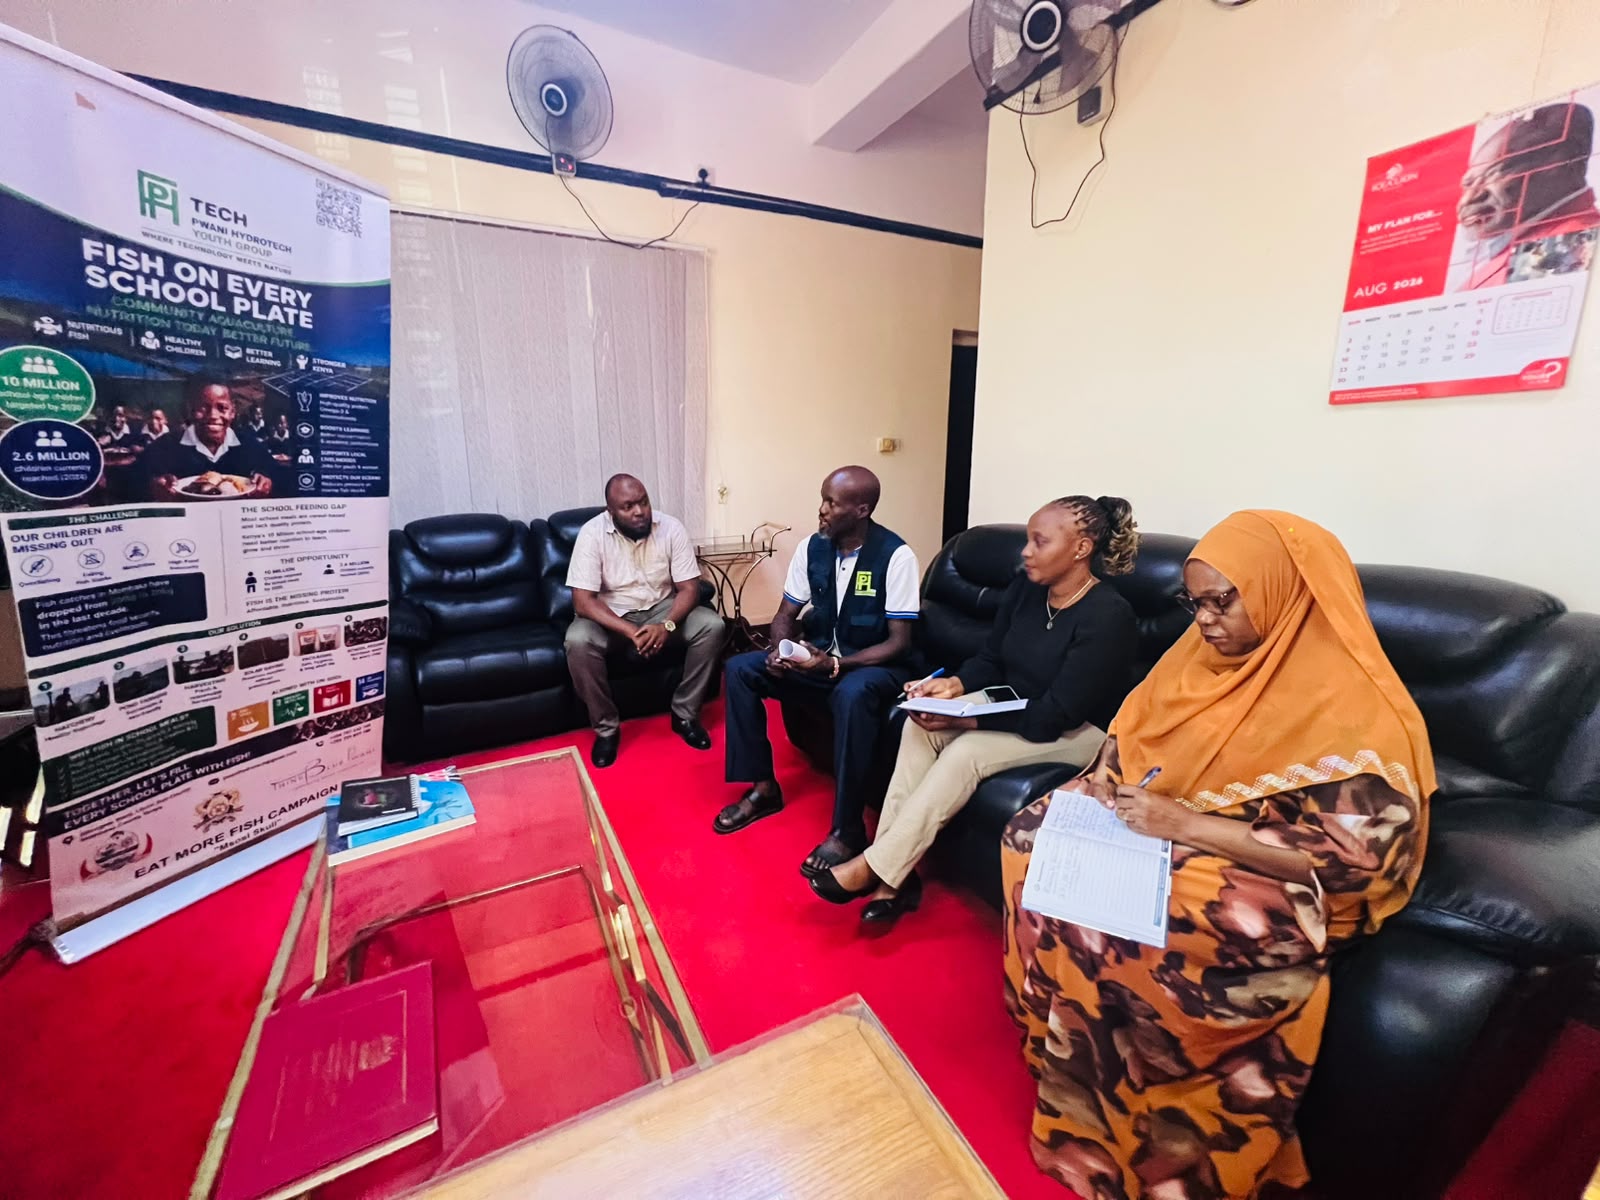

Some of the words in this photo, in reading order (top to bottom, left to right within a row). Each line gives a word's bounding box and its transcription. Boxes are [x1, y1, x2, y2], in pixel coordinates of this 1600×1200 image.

[190, 197, 248, 227] TECH
[1368, 224, 1383, 234] MY
[1384, 216, 1412, 230] PLAN
[192, 218, 228, 235] PWANI
[232, 230, 292, 253] HYDROTECH
[192, 229, 232, 248] YOUTH
[236, 242, 272, 258] GROUP
[142, 231, 174, 246] WHERE
[178, 240, 232, 260] TECHNOLOGY
[264, 264, 292, 276] NATURE
[82, 238, 165, 277] FISH
[173, 260, 218, 288] ON
[227, 273, 312, 308] EVERY
[1354, 282, 1387, 298] AUG
[1393, 276, 1423, 290] 2026
[84, 264, 226, 312] SCHOOL
[233, 296, 314, 328] PLATE
[111, 294, 204, 322] COMMUNITY
[208, 314, 294, 338] AQUACULTURE
[66, 320, 122, 336] NUTRITIOUS
[86, 304, 171, 328] NUTRITION
[176, 318, 218, 336] TODAY
[222, 328, 268, 346] BETTER
[68, 330, 90, 341] FISH
[164, 334, 202, 346] HEALTHY
[165, 344, 206, 357] CHILDREN
[246, 348, 273, 358] BETTER
[2, 376, 20, 387] 10
[22, 378, 80, 391] MILLION
[12, 452, 34, 462] 2.6
[36, 452, 90, 462] MILLION
[68, 515, 88, 524] THE
[89, 510, 140, 522] CHALLENGE
[10, 532, 39, 543] OUR
[42, 526, 102, 540] CHILDREN
[104, 524, 124, 533] ARE
[12, 540, 67, 554] MISSING
[70, 537, 94, 548] OUT
[296, 554, 350, 562] OPPORTUNITY
[36, 605, 82, 621] dropped
[52, 617, 70, 627] the
[170, 764, 191, 778] FILL
[64, 808, 107, 830] EVERY
[111, 788, 160, 811] SCHOOL
[160, 773, 193, 790] PLATE
[195, 761, 224, 775] WITH
[133, 857, 170, 880] EAT
[174, 832, 226, 862] MORE
[229, 816, 264, 838] FISH
[266, 784, 340, 821] CAMPAIGN
